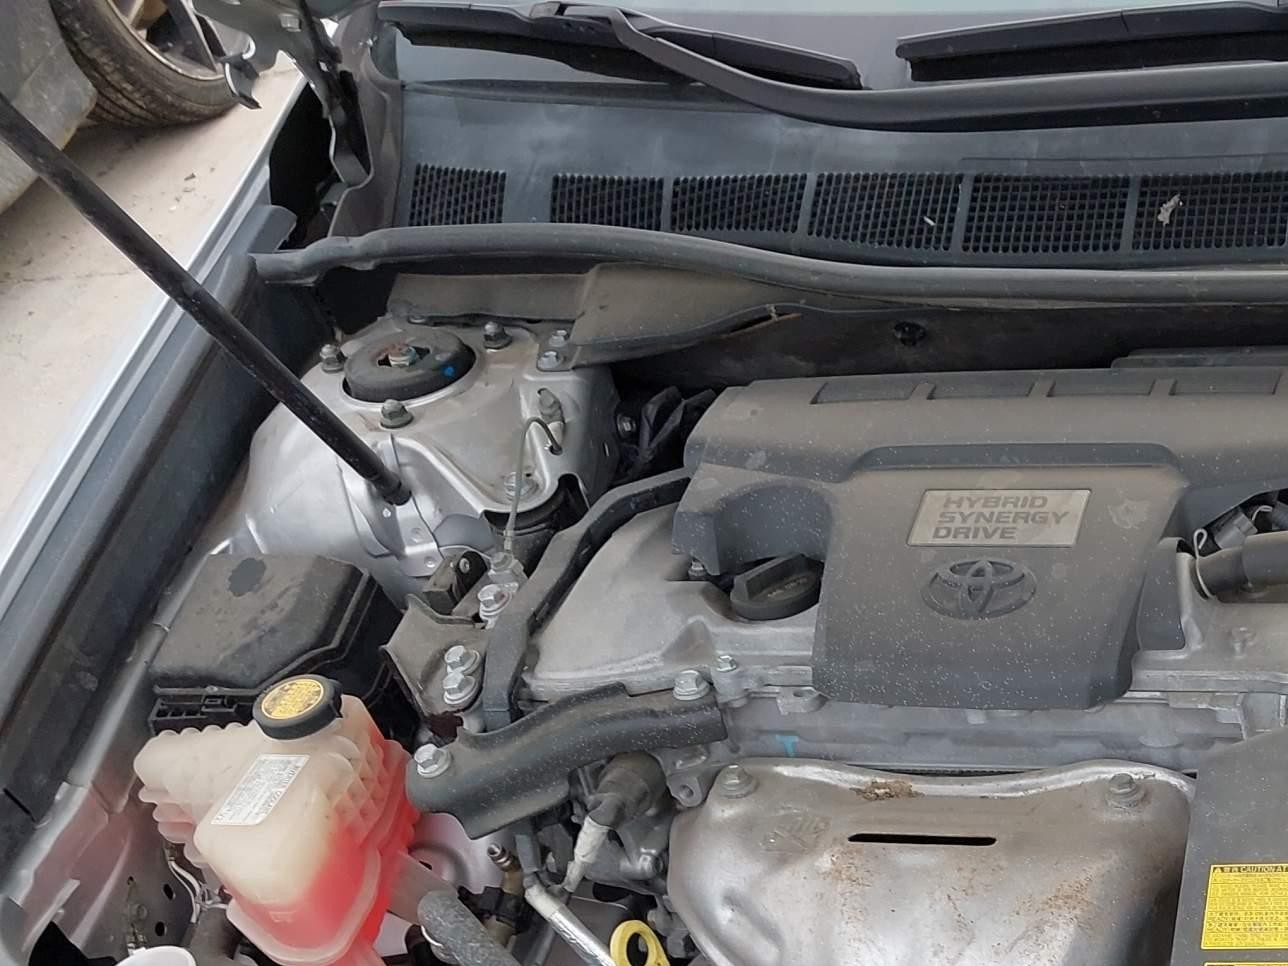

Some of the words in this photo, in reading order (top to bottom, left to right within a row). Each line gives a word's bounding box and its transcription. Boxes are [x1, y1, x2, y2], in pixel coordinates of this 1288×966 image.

[943, 496, 1048, 508] HYBRID
[937, 511, 1070, 524] SYNERGY
[932, 526, 1017, 539] DRIVE
